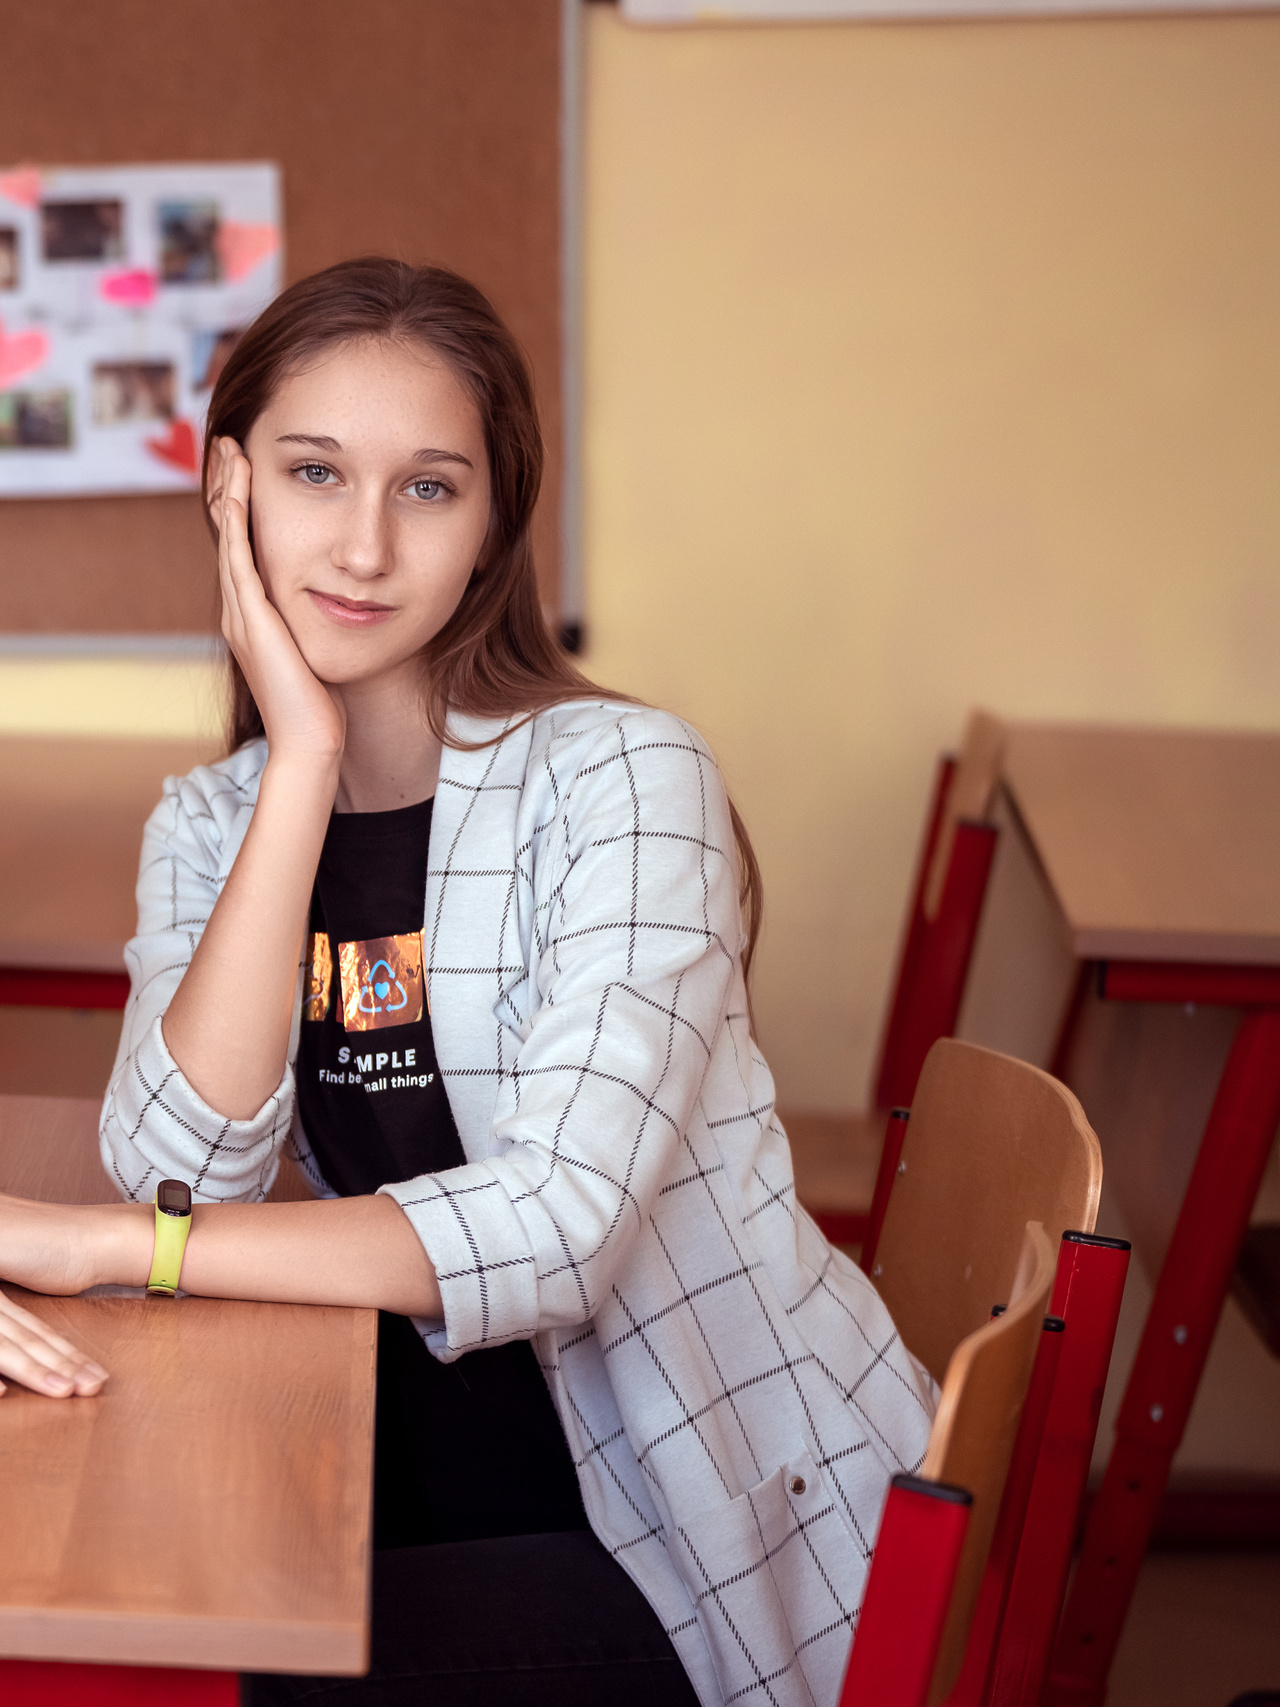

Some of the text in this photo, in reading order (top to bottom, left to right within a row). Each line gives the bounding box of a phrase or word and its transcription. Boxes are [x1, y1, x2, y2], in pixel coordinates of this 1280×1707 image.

[338, 1046, 416, 1073] SMPLE
[319, 1069, 345, 1084] Find
[390, 1073, 434, 1088] things
